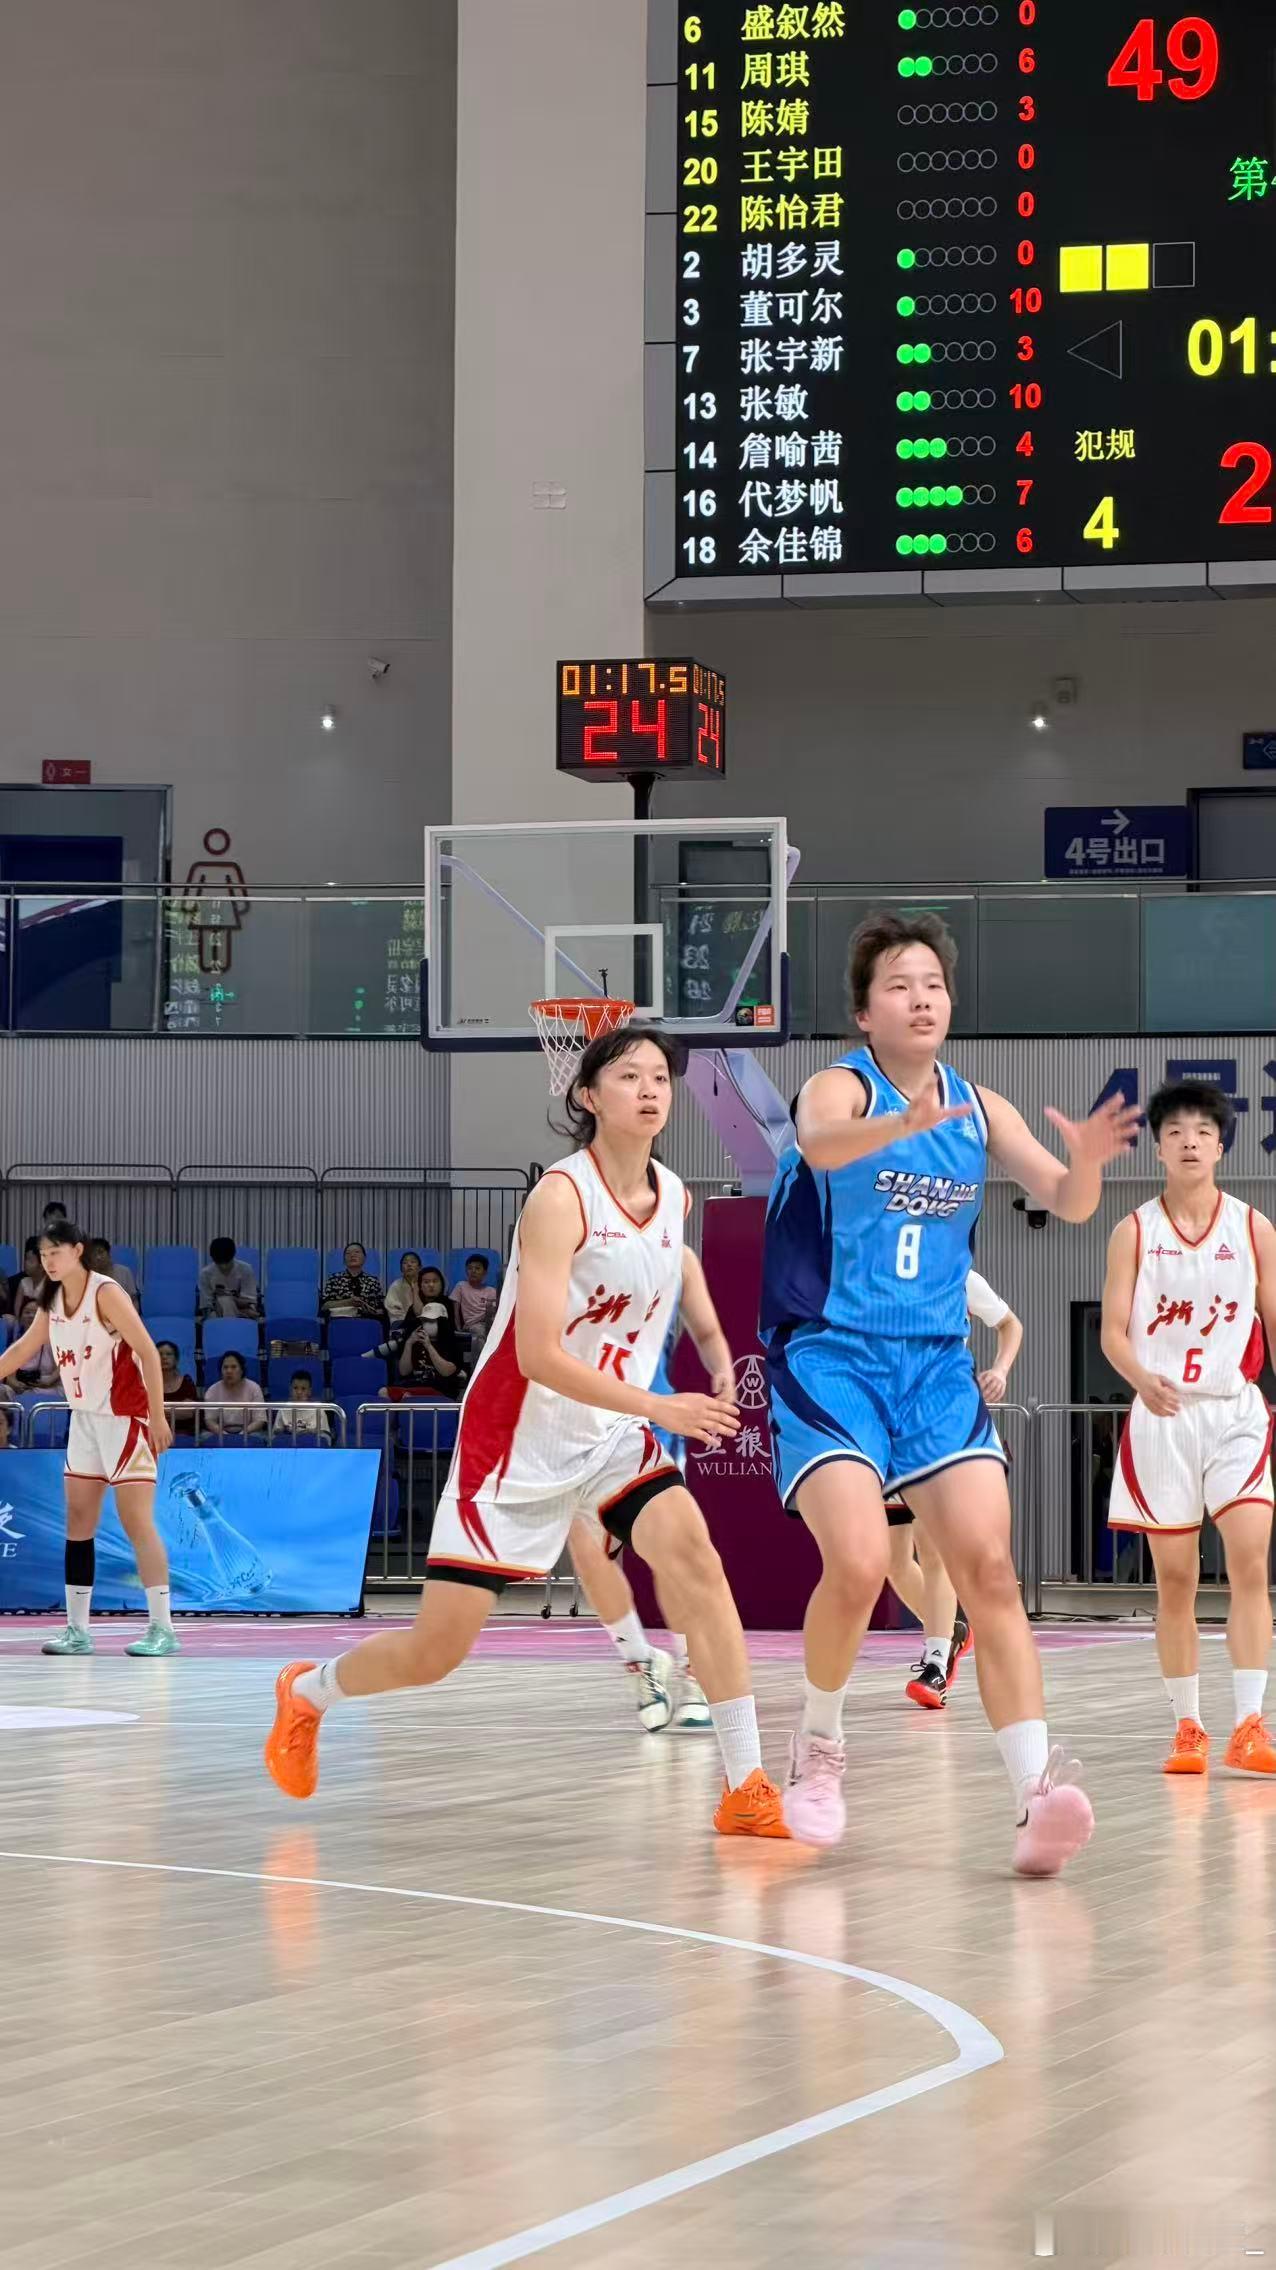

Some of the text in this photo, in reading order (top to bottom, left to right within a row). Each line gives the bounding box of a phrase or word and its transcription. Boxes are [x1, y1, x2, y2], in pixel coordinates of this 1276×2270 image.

[684, 0, 1035, 43] 6 盛叙然 0
[685, 48, 1035, 90] 11 周琪 6
[1107, 17, 1219, 101] 49
[685, 96, 1035, 137] 15 陈婧 3
[683, 144, 1034, 185] 20 王宇田 0
[1228, 157, 1276, 200] 第
[683, 192, 1034, 233] 22 陈怡君 0
[683, 240, 1034, 280] 2 胡多灵 0
[683, 288, 1042, 327] 3 董可尔 10
[683, 335, 1034, 374] 7 张宇新 3
[684, 383, 1041, 421] 13 张敏 10
[684, 430, 1034, 470] 14 詹喻茜 4
[1074, 429, 1135, 461] 犯规
[683, 479, 1033, 517] 16 代梦帆 7
[1219, 442, 1273, 524] 2
[1083, 497, 1119, 549] 4
[683, 526, 1033, 564] 18 余佳锦 6
[562, 664, 687, 695] 01:17.5
[584, 700, 665, 760] 24
[698, 702, 719, 768] 24
[1065, 836, 1165, 866] 4号出口
[874, 1169, 954, 1200] SHAN
[896, 1224, 923, 1279] 8
[1147, 1294, 1238, 1336] 浙江
[1183, 1348, 1203, 1382] 6
[697, 1462, 773, 1476] WULIAN
